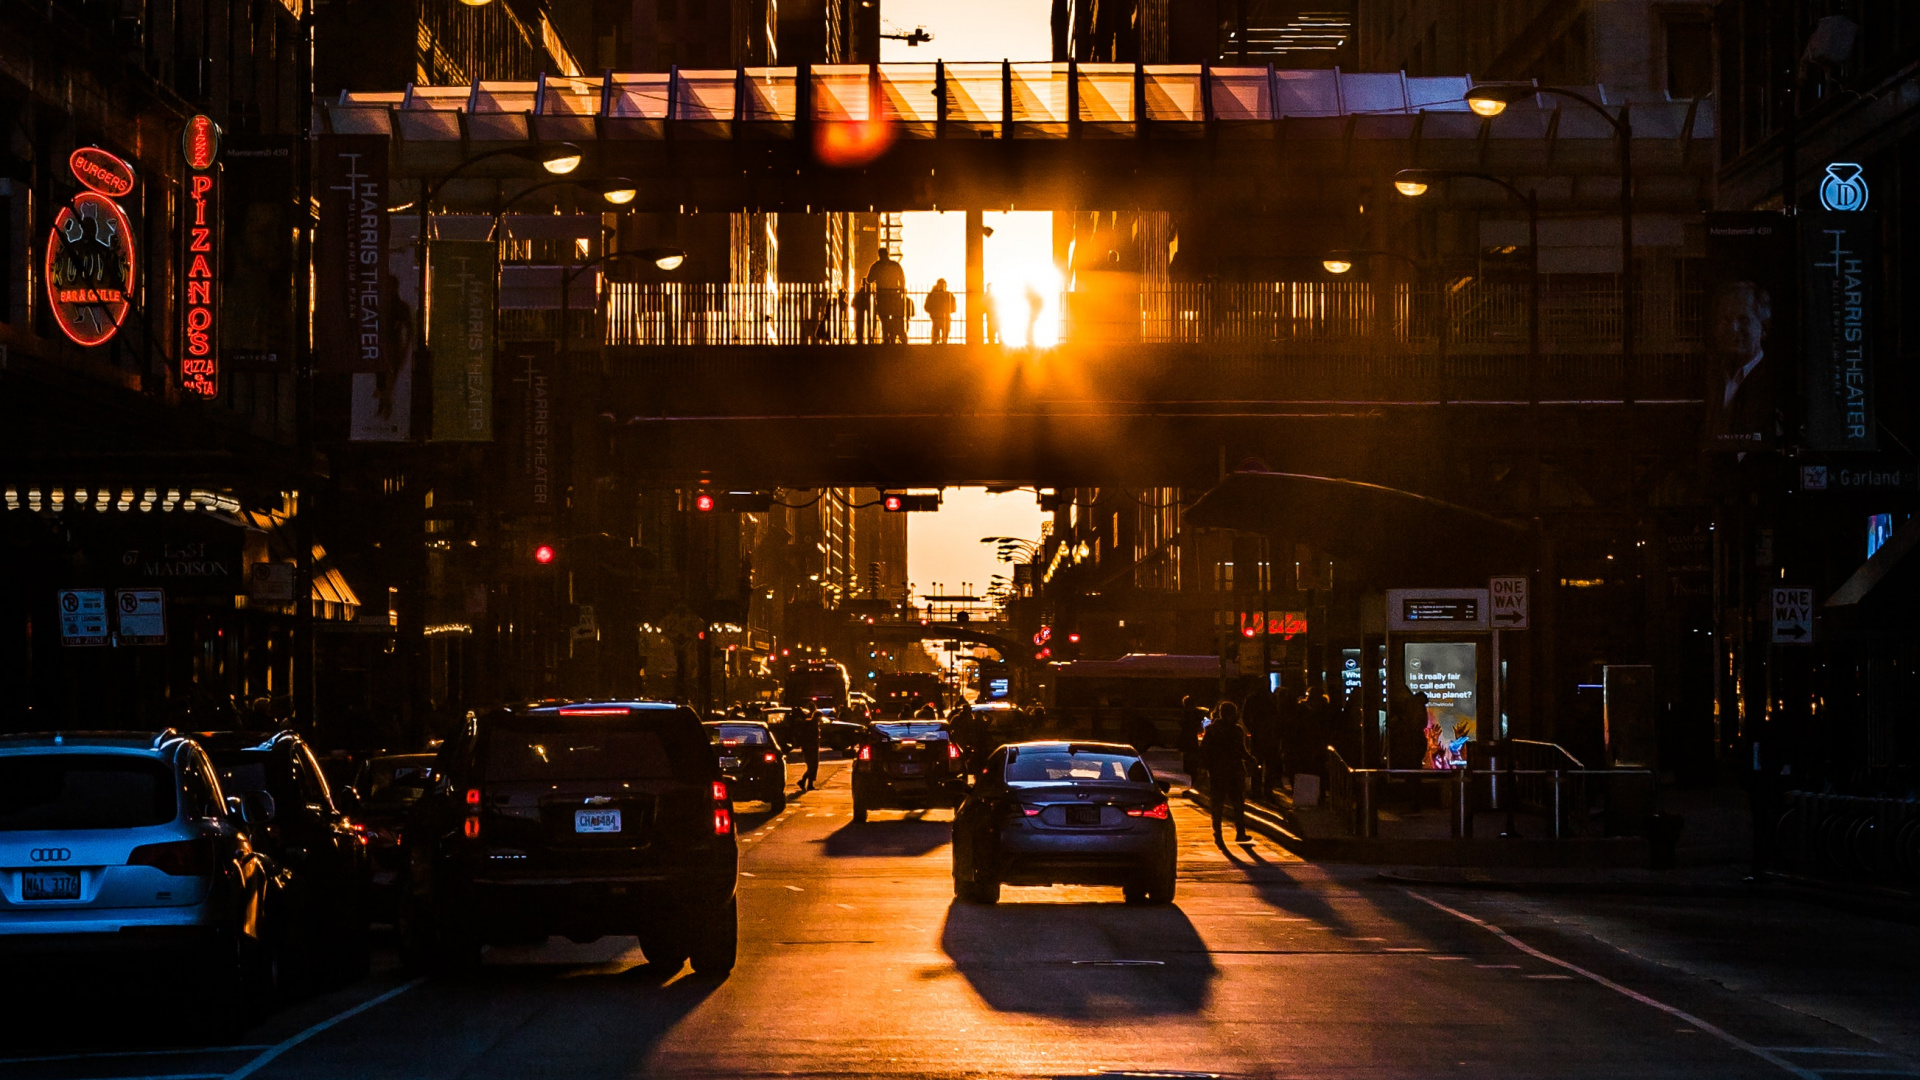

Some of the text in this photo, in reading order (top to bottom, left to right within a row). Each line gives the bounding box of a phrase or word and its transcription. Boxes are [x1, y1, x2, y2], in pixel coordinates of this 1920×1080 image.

[194, 117, 207, 166] PIZZA
[75, 156, 128, 191] BURGERS
[187, 176, 213, 356] PIZANO'S
[360, 182, 379, 360] HARRIS THEATER
[60, 290, 78, 302] BAR
[87, 289, 121, 302] GILLE
[468, 281, 485, 431] HARRIS THEATER
[1844, 259, 1866, 440] HARRIS THEATER
[184, 359, 214, 375] PIZZA
[534, 376, 548, 504] HARRIS THEATER
[1840, 469, 1900, 486] Garland
[122, 550, 139, 565] 67
[144, 560, 228, 576] MADISON
[1494, 581, 1523, 593] ONE
[1494, 595, 1524, 608] WAY
[1776, 591, 1808, 605] ONE
[1775, 607, 1809, 621] WAY
[1424, 673, 1446, 682] really
[1442, 690, 1473, 699] planet?
